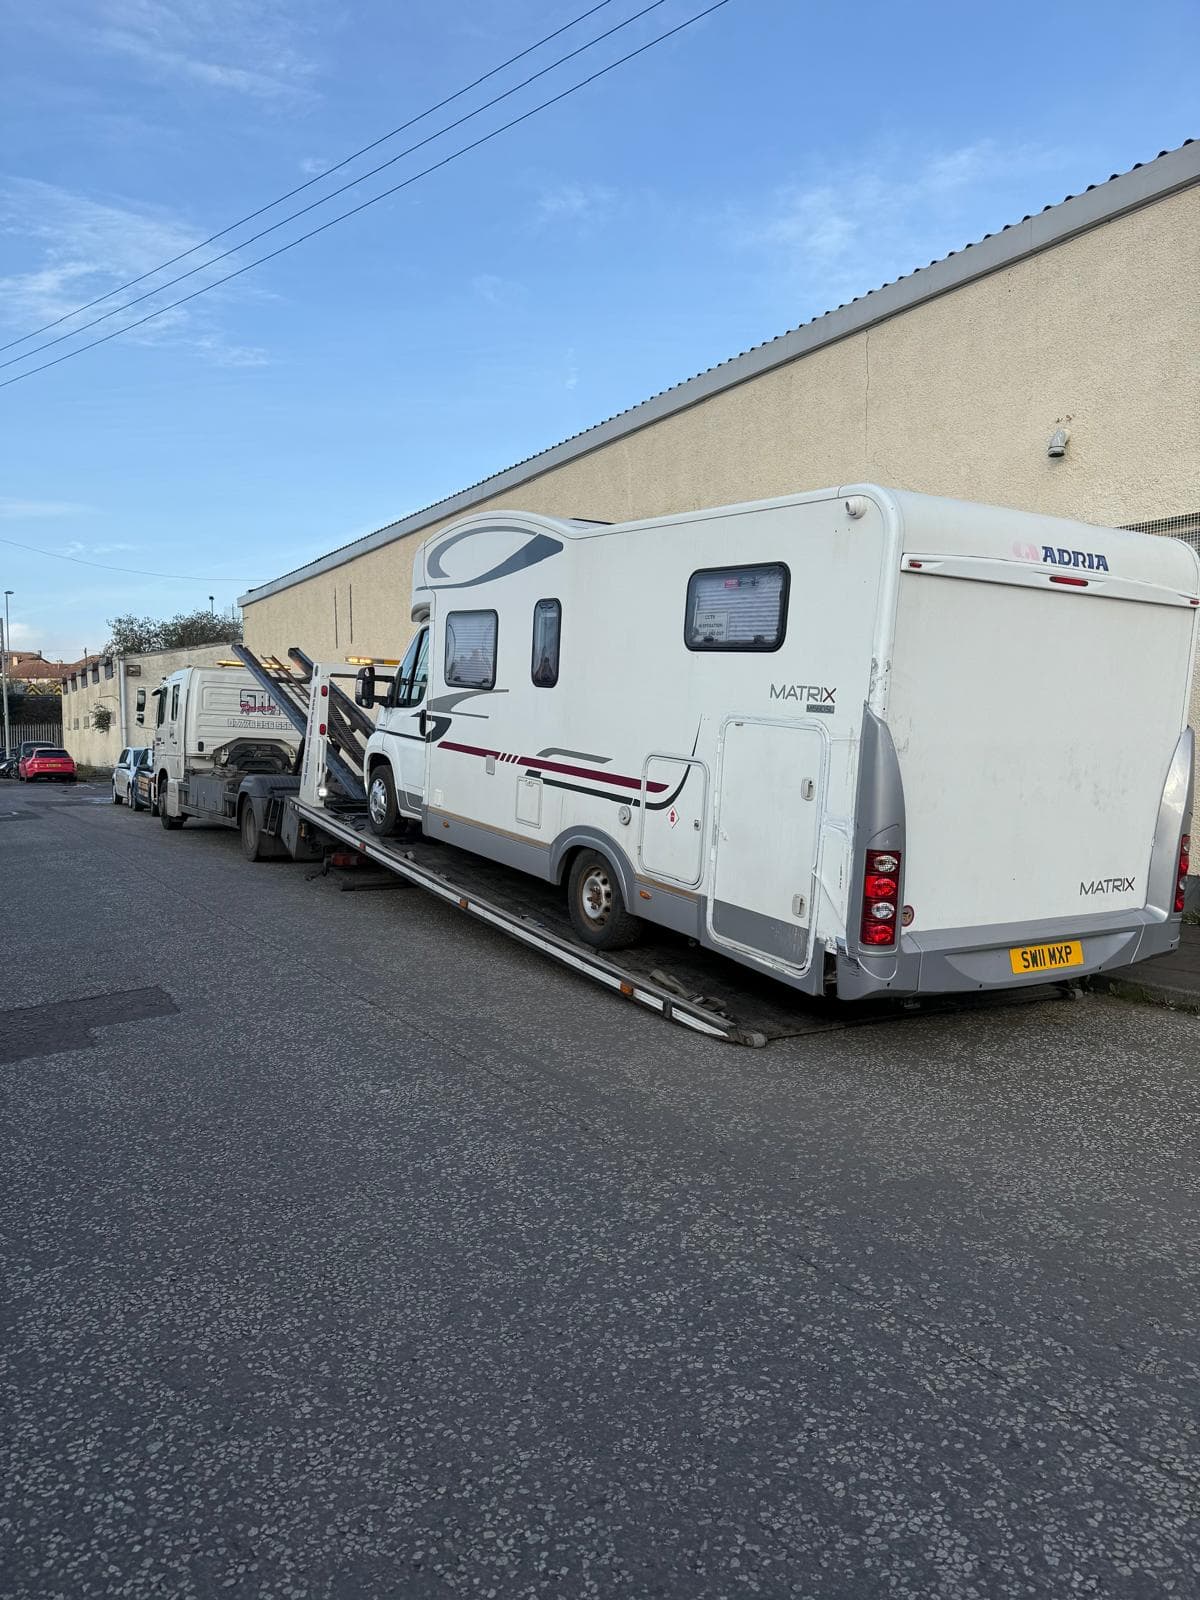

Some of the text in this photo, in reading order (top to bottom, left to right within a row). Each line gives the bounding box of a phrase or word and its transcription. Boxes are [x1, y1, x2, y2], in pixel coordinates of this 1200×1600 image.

[1041, 545, 1109, 572] ADRIA
[770, 683, 837, 703] MATRIX
[1079, 877, 1136, 895] MATRIX
[1021, 945, 1072, 969] SW11 MXP
